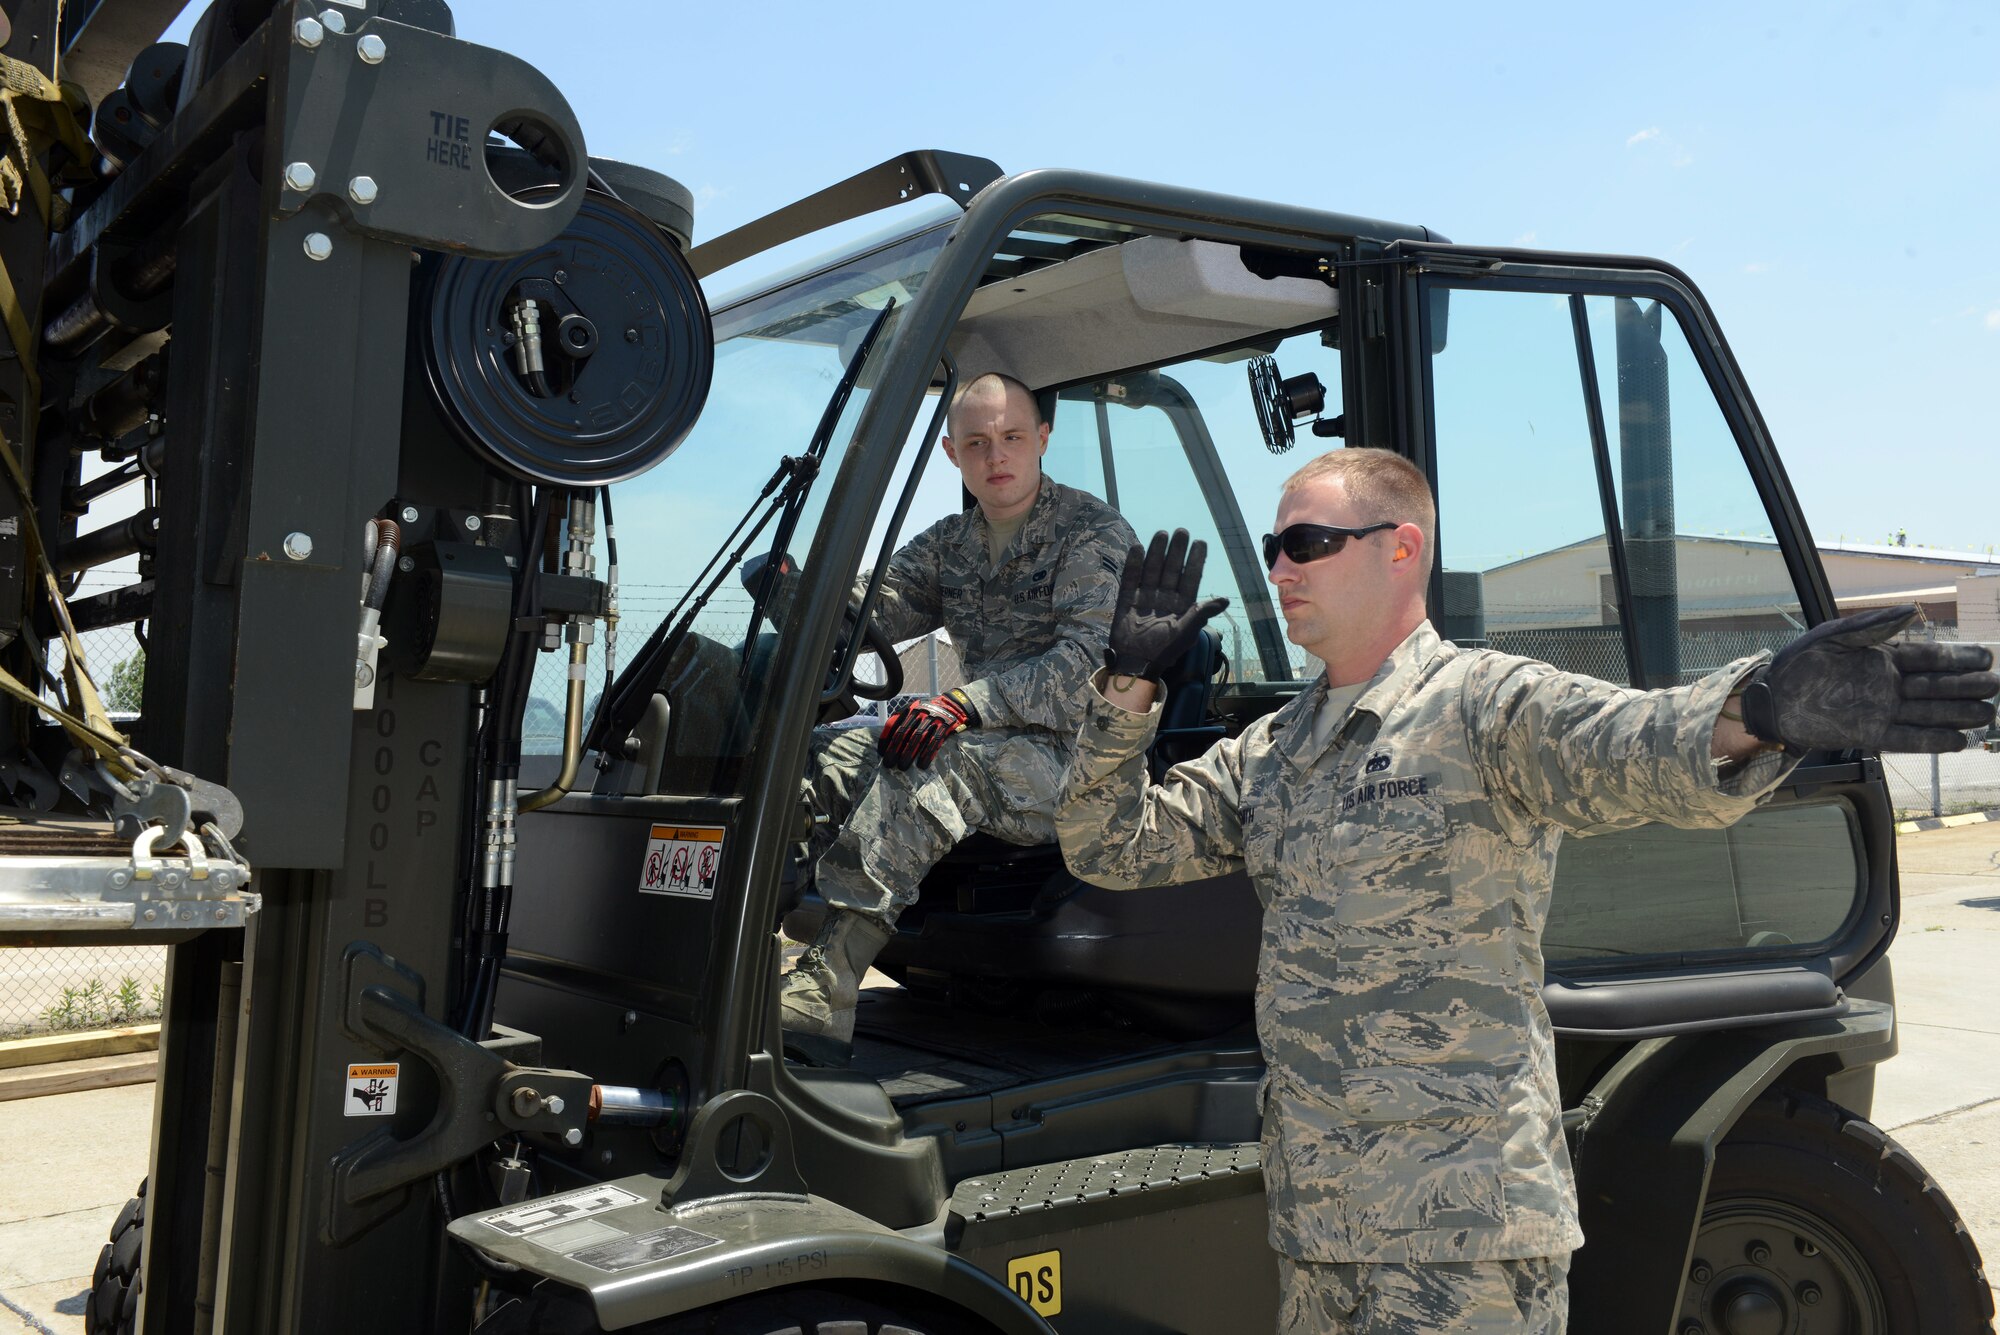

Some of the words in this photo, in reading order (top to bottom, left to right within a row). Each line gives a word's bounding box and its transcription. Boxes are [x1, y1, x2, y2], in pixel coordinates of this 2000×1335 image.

[430, 110, 469, 143] TIE
[427, 137, 472, 170] HERE
[416, 740, 443, 836] CAP
[1357, 784, 1376, 805] AIR
[1379, 777, 1428, 800] FORCE
[680, 831, 699, 839] WARNING
[361, 1068, 396, 1076] WARNING
[728, 1265, 753, 1287] TP
[797, 1250, 828, 1273] PSI
[1016, 1265, 1054, 1305] DS
